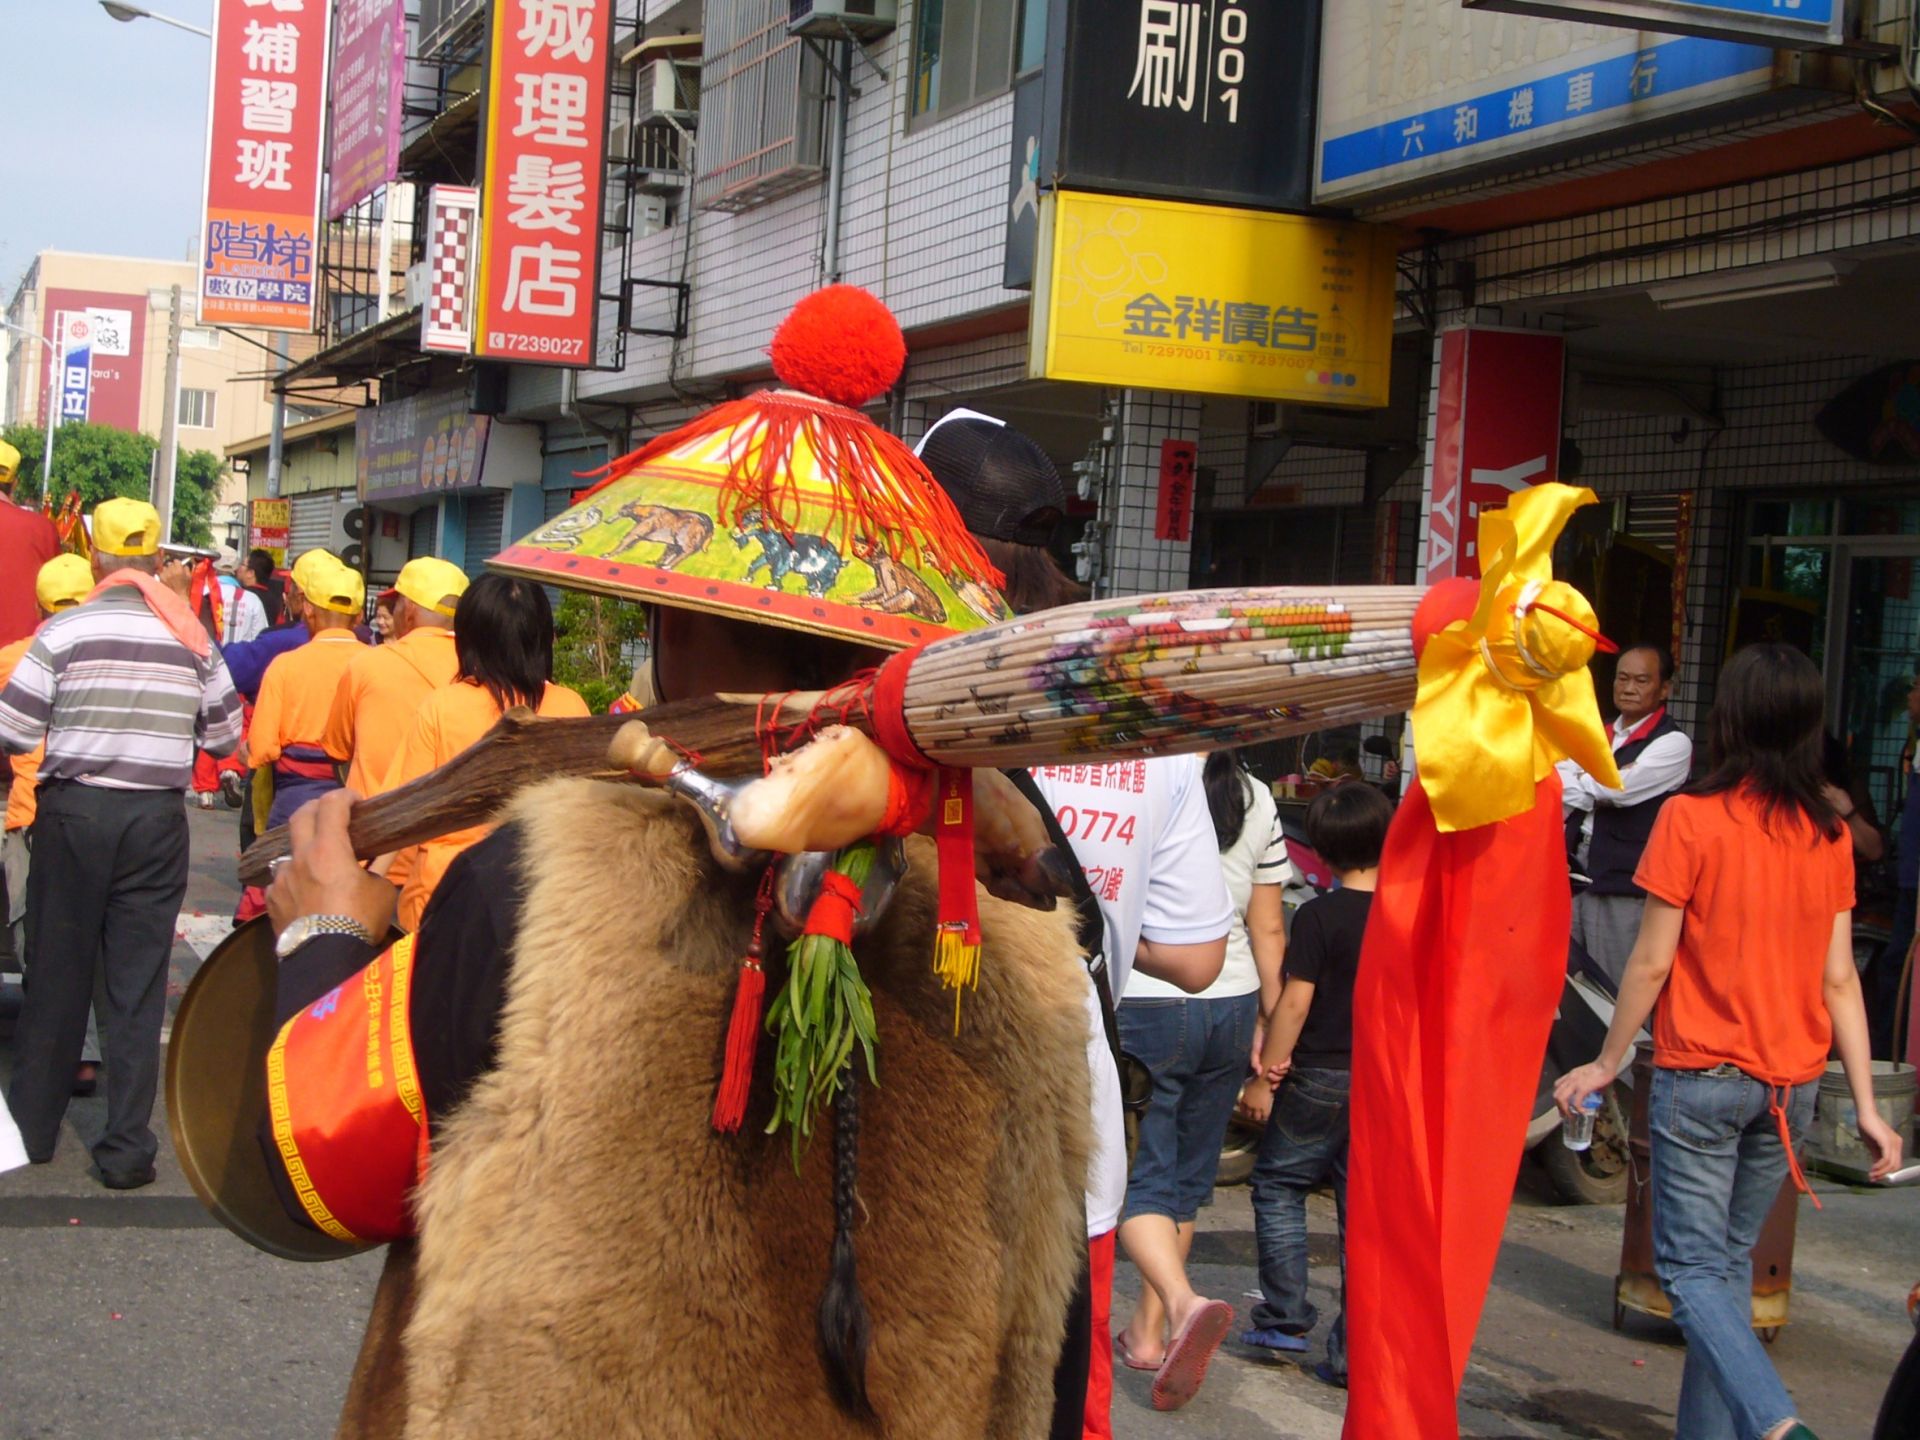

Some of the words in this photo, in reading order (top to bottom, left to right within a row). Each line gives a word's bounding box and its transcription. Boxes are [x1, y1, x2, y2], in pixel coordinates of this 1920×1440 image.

[234, 0, 304, 191] 補習班
[1402, 52, 1659, 158] 六和機車行
[507, 333, 583, 356] 7239027
[1123, 292, 1319, 352] 金祥廣告
[1122, 341, 1143, 353] Tel
[1147, 345, 1212, 361] 7297001
[1218, 349, 1245, 363] Fax
[1248, 354, 1315, 369] 7297007
